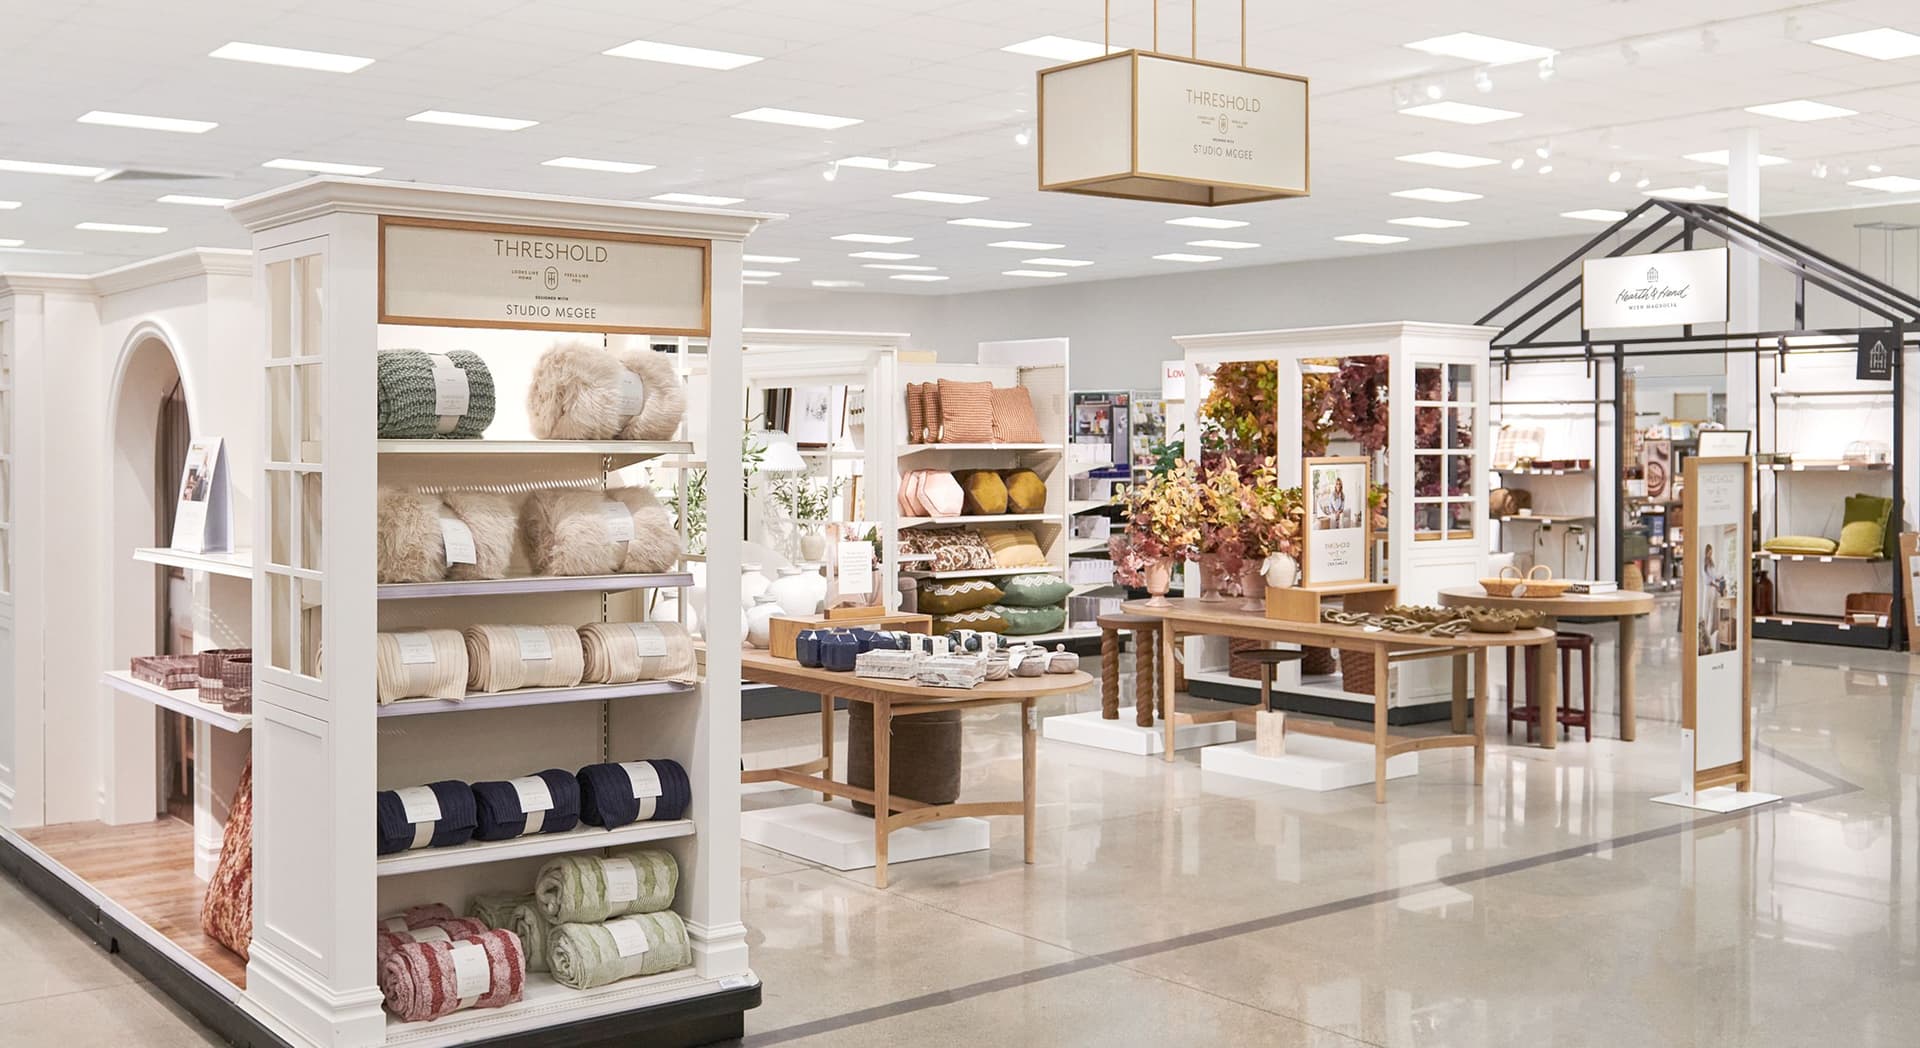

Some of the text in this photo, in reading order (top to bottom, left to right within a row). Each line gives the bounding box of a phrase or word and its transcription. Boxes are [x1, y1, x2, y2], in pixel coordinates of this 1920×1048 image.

[1186, 88, 1261, 113] THRESHOLD
[1193, 144, 1223, 157] STUDIO
[494, 239, 608, 263] THRESHOLD
[1616, 285, 1653, 304] Hearth
[1657, 284, 1690, 299] Hand
[506, 304, 551, 317] STUDIO
